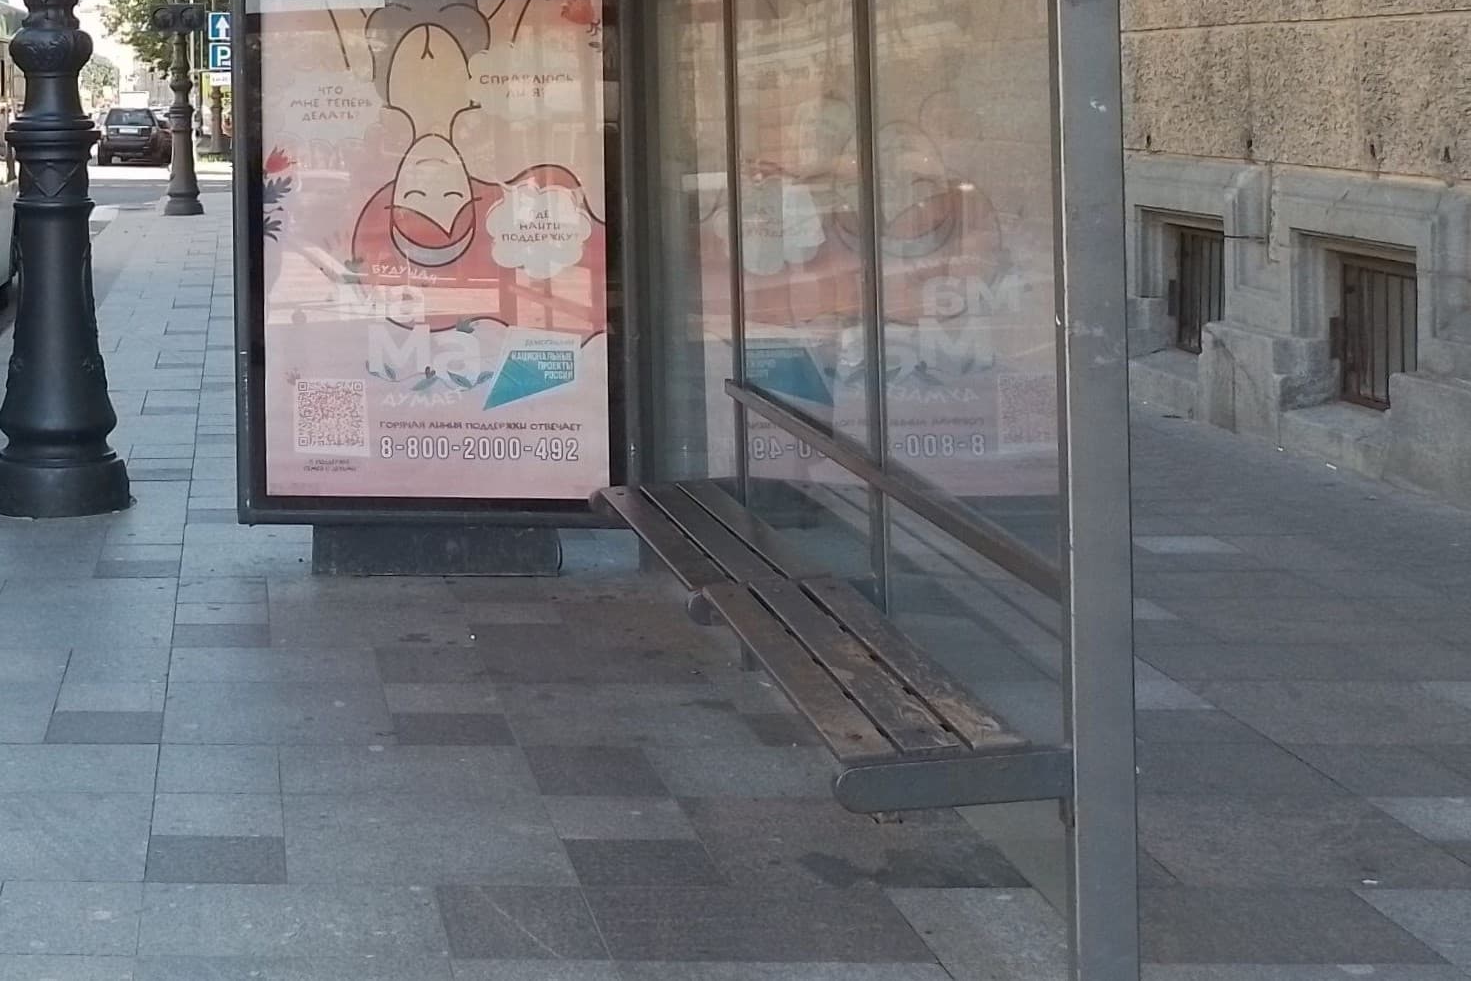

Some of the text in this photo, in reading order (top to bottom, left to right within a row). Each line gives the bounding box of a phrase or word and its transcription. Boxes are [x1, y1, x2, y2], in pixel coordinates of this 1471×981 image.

[318, 85, 343, 96] ЧТО
[290, 98, 372, 108] МНЕ ТЕПЕРЬ
[537, 361, 573, 370] ПРОЕКТЫ
[544, 371, 573, 380] РОССИИ
[380, 421, 426, 430] ГОРЯЧАЯ
[465, 422, 527, 431] ПОДДЕРЖКИ
[530, 423, 582, 431] ОТВЕЧАЕТ
[380, 435, 579, 461] 8-800-2000-492
